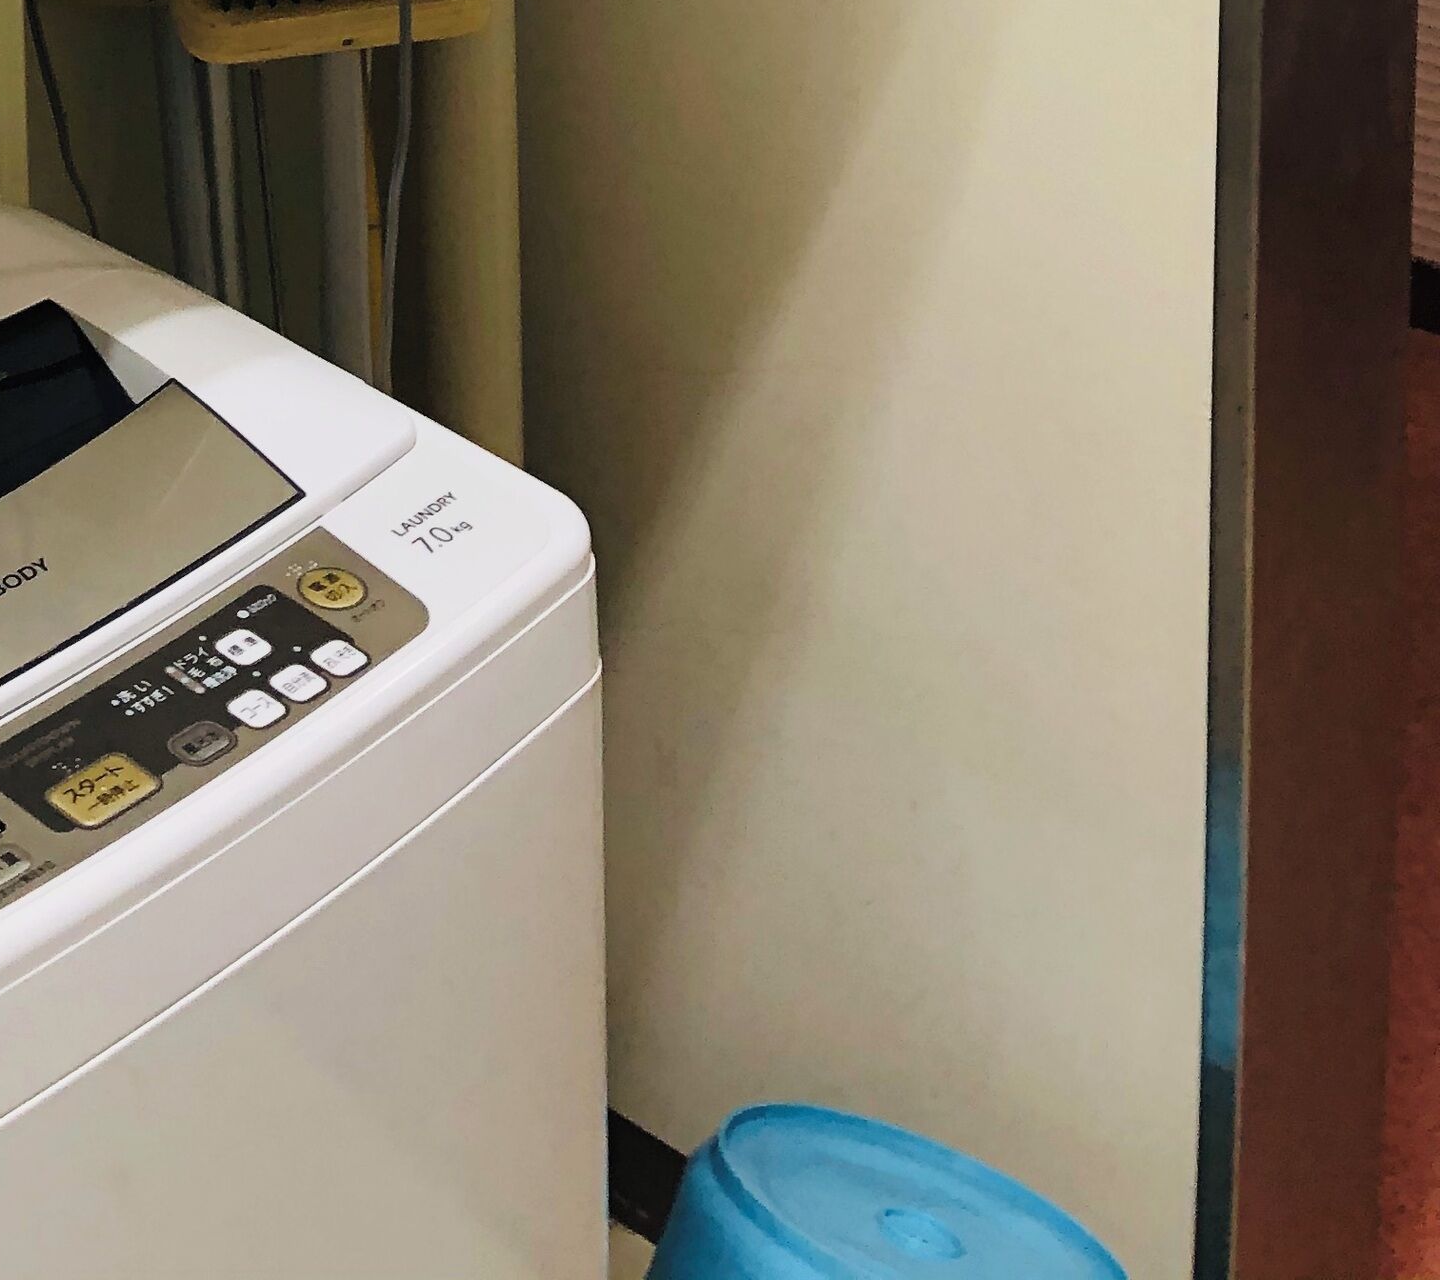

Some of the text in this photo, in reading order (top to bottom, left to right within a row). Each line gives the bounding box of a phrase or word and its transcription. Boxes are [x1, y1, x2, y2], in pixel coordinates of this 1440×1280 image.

[391, 491, 457, 537] LAUNDRY
[173, 647, 209, 670] ドライ
[240, 697, 274, 719] コース
[63, 766, 124, 804] スタート
